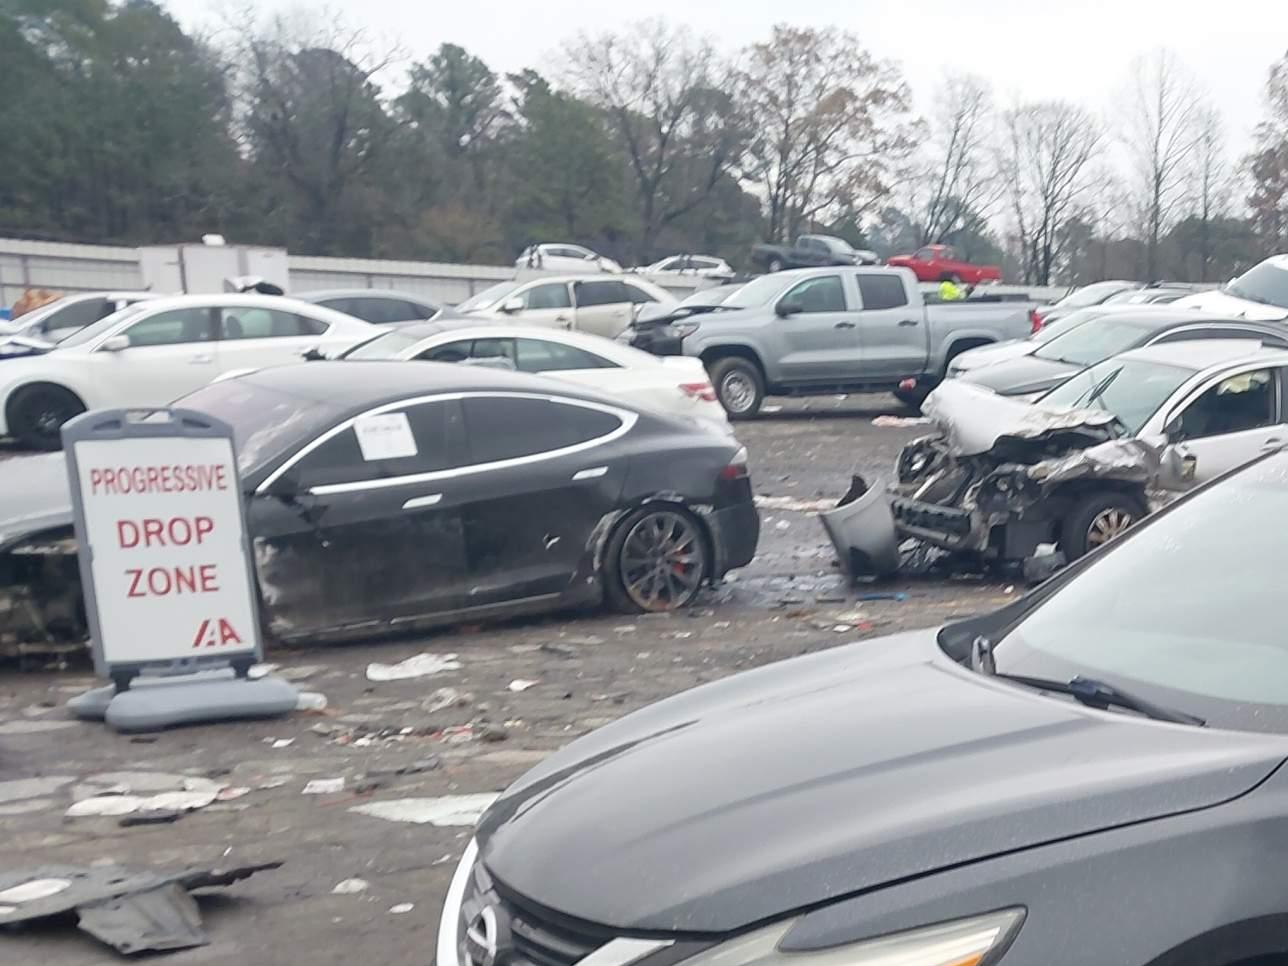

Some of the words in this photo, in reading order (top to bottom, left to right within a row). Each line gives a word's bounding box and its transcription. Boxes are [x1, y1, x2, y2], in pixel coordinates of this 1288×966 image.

[90, 463, 228, 496] PROGRESSIVE
[117, 516, 215, 549] DROP
[124, 564, 220, 599] ZONE
